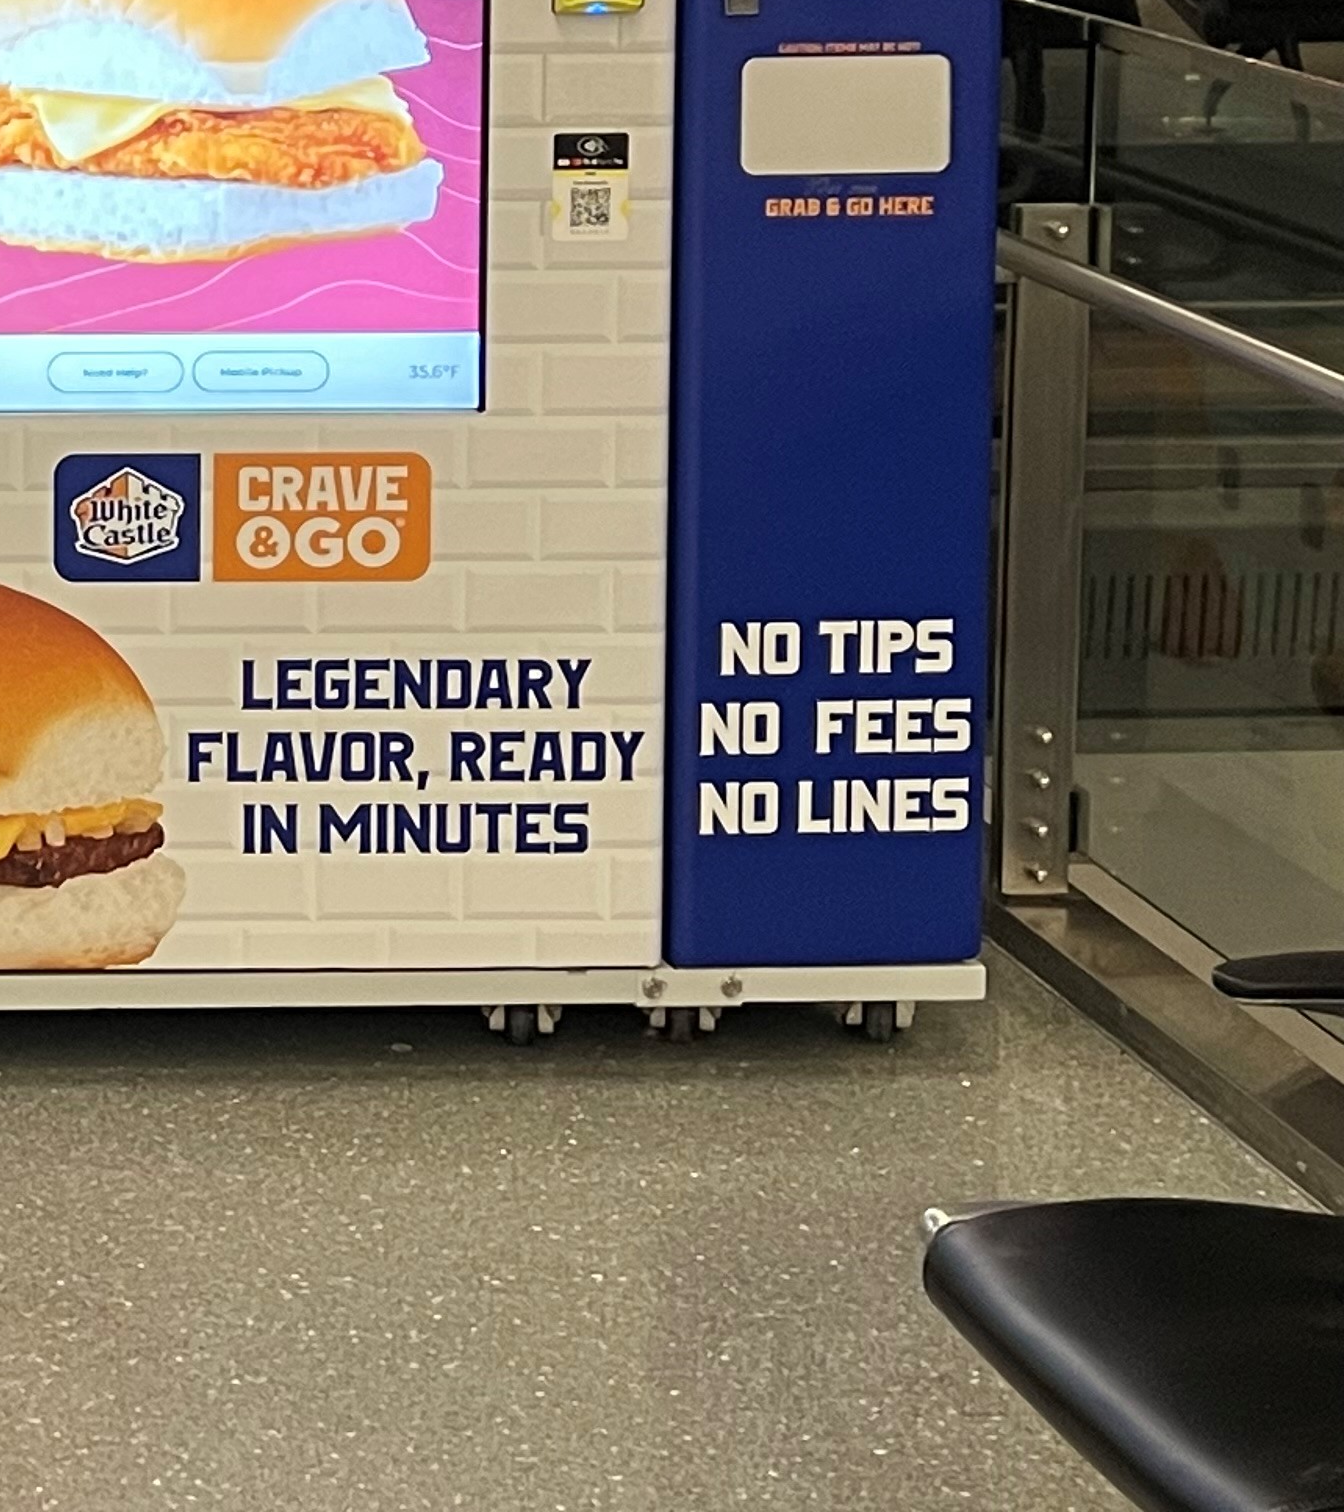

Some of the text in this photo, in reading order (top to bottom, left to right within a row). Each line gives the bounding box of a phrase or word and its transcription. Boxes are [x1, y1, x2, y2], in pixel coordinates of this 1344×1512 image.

[765, 195, 934, 217] GRAB & GO HERE
[408, 364, 461, 380] 35.6°F
[89, 496, 169, 528] White
[239, 465, 408, 512] CRAVE
[80, 522, 176, 549] Castle
[720, 619, 955, 676] NO TIPS
[241, 659, 592, 710] LEGENDARY
[700, 699, 972, 757] NO FEES
[187, 730, 645, 790] FLAVOR, READY
[243, 803, 590, 854] IN MINUTES
[699, 777, 971, 836] NO LINES
